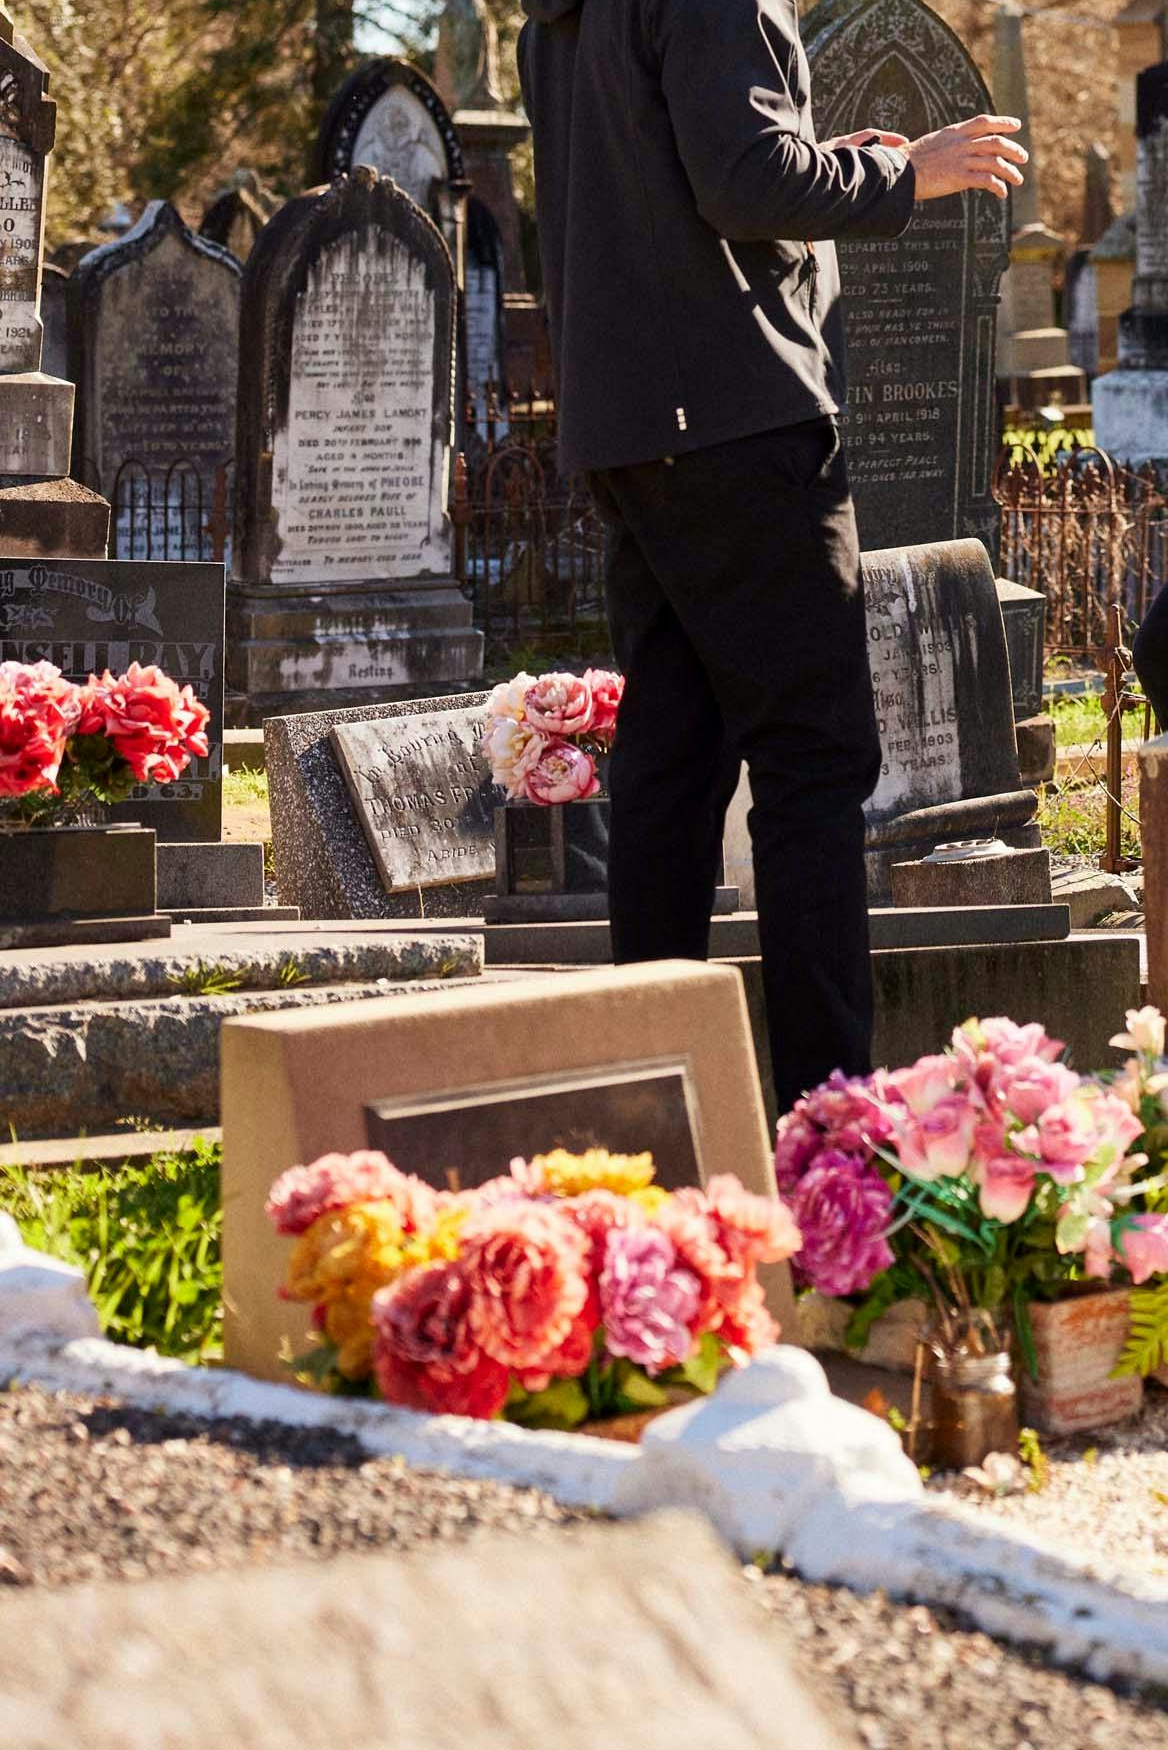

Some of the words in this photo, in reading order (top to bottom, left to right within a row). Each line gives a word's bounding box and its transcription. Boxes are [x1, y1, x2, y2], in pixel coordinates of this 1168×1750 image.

[883, 381, 959, 402] BROOKES
[295, 410, 331, 420] PERCY
[336, 409, 376, 419] JAMES
[383, 408, 428, 419] LAMONT
[876, 411, 913, 423] APRIL
[916, 408, 941, 420] 1918
[316, 452, 345, 461] AGED
[380, 476, 424, 488] PHEOBE
[308, 507, 364, 519] CHARLES
[370, 505, 407, 517] PAULL
[922, 640, 952, 656] 1903
[348, 664, 394, 680] Resting
[897, 707, 958, 731] WILLIS
[921, 732, 954, 748] 1903
[364, 790, 448, 816] THOMAS
[380, 824, 422, 841] DIED
